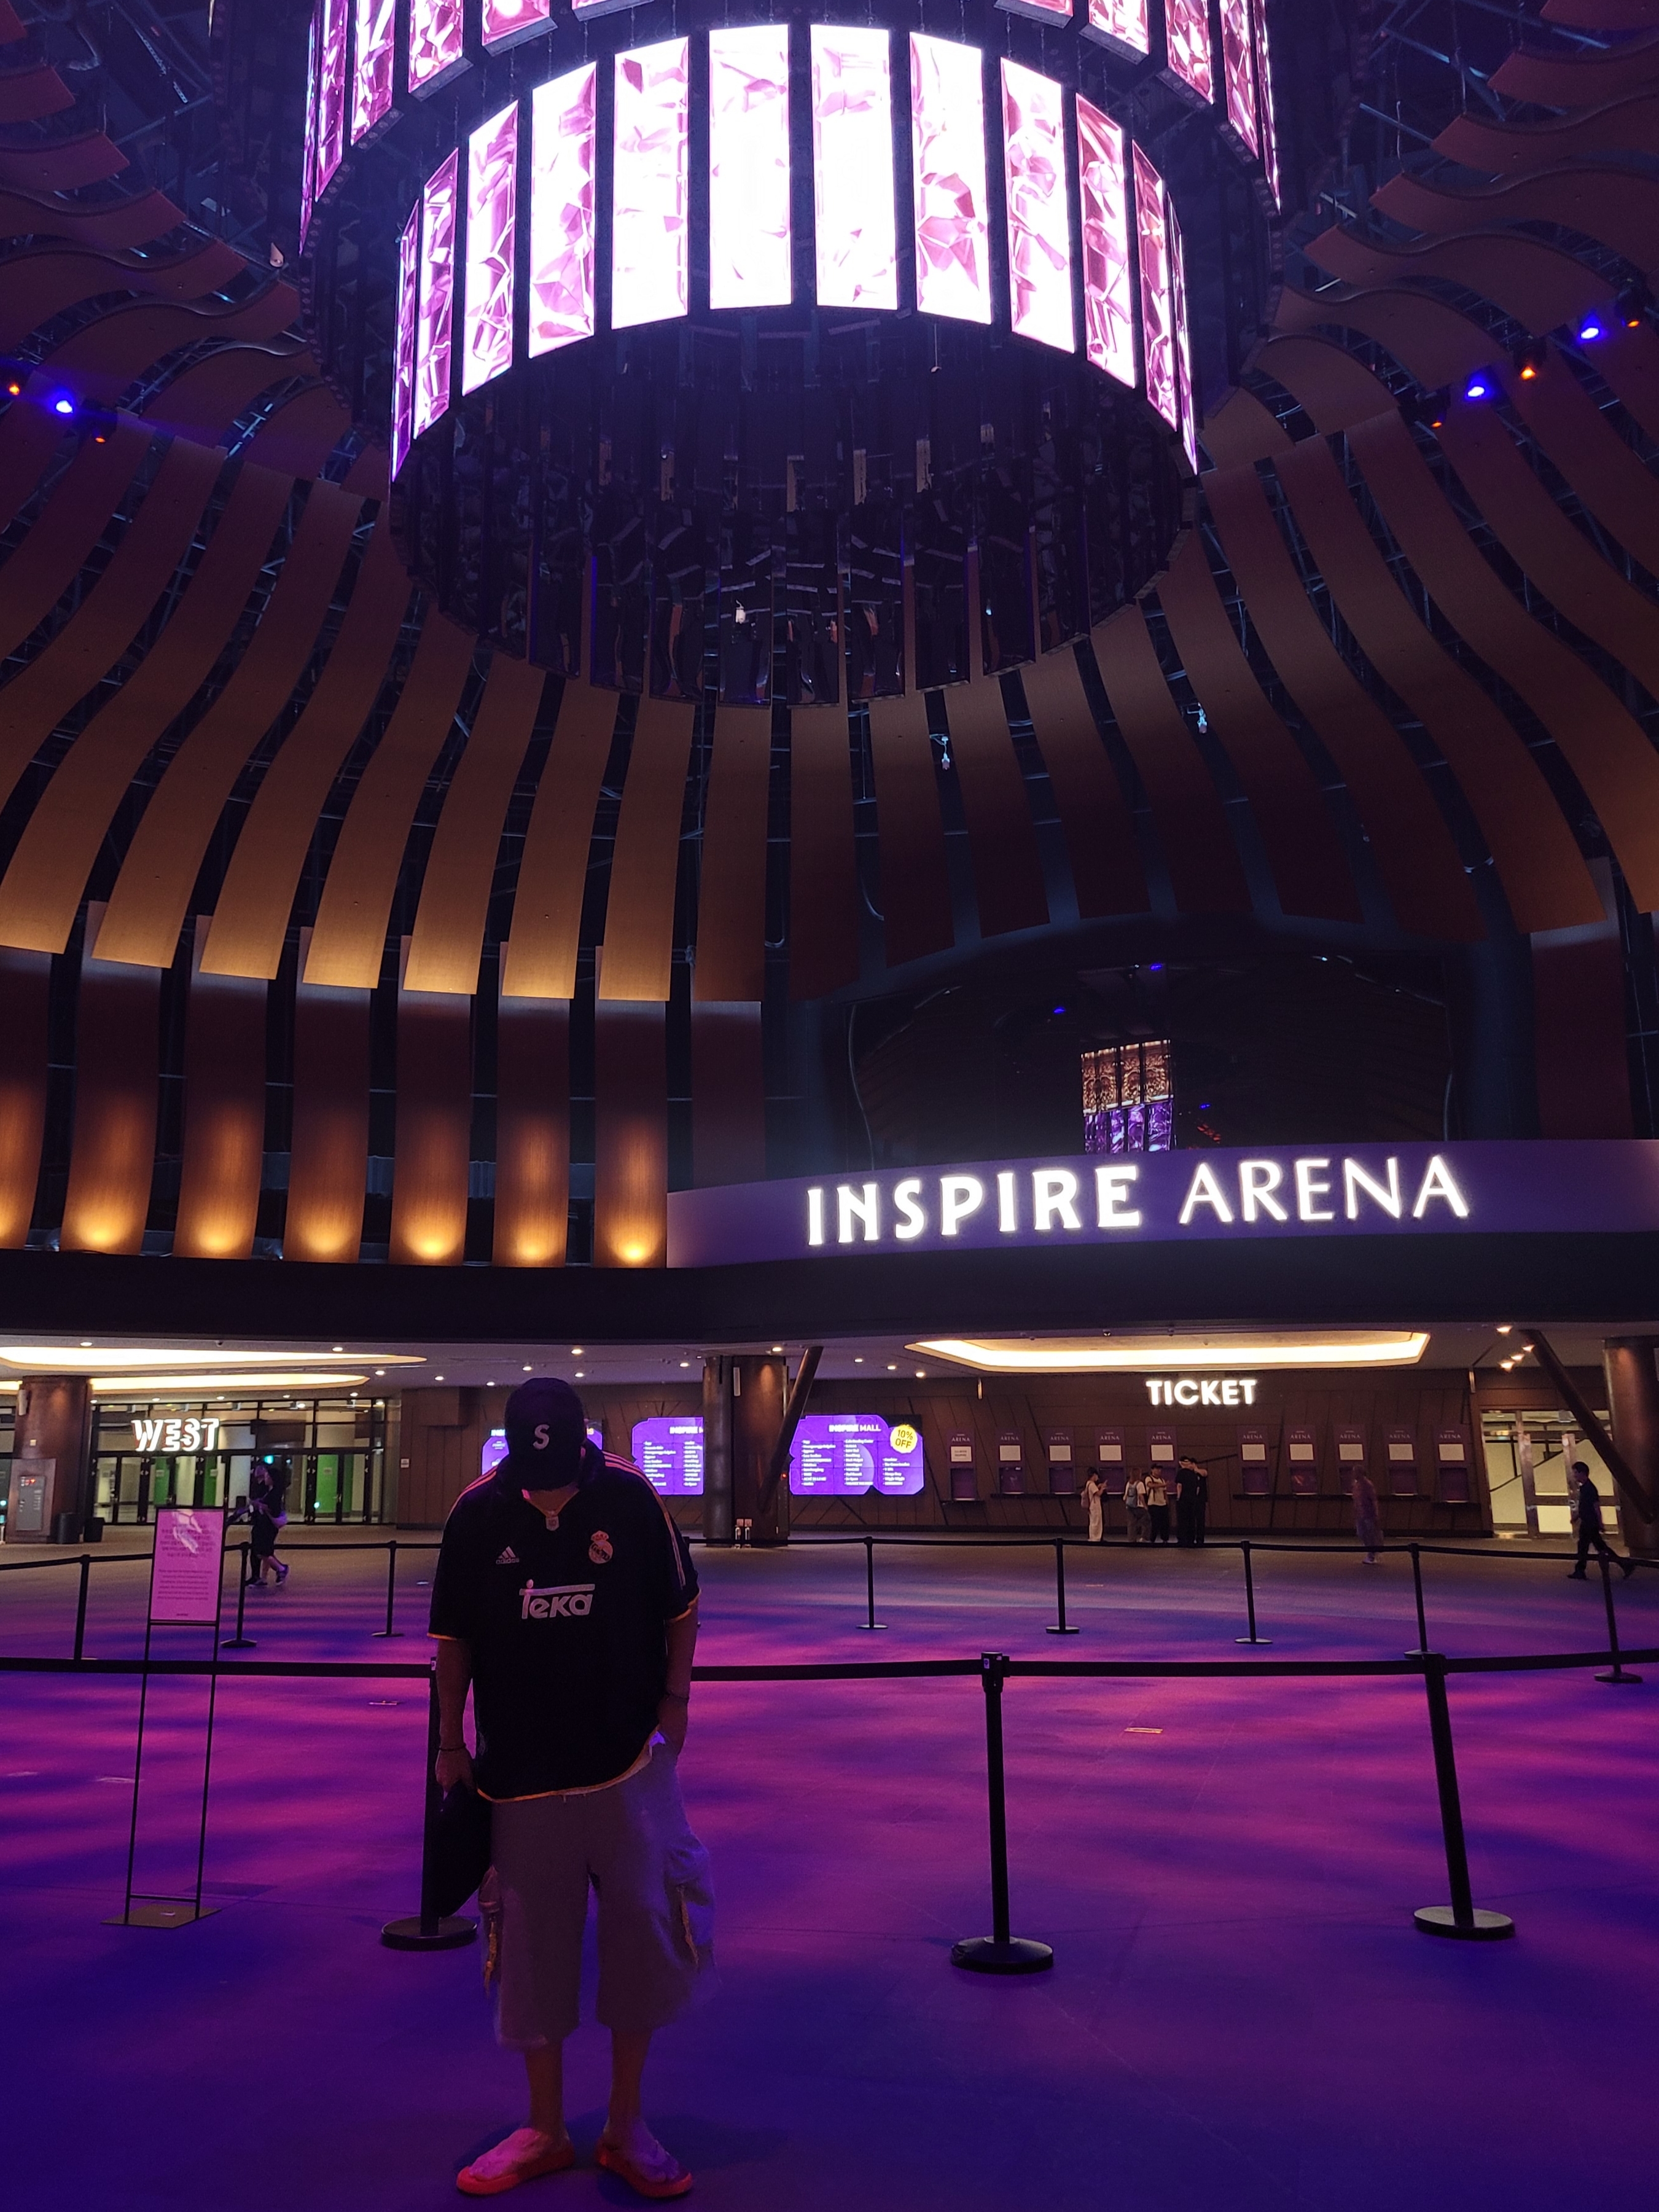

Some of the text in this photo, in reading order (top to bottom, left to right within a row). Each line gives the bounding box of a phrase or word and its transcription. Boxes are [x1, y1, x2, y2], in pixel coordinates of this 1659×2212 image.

[806, 1155, 1469, 1246] INSPIRE ARENA
[1146, 1380, 1257, 1405] TICKET
[131, 1418, 219, 1452] WEST
[533, 1424, 550, 1450] S
[895, 1438, 912, 1448] OFF
[898, 1429, 913, 1440] 10%
